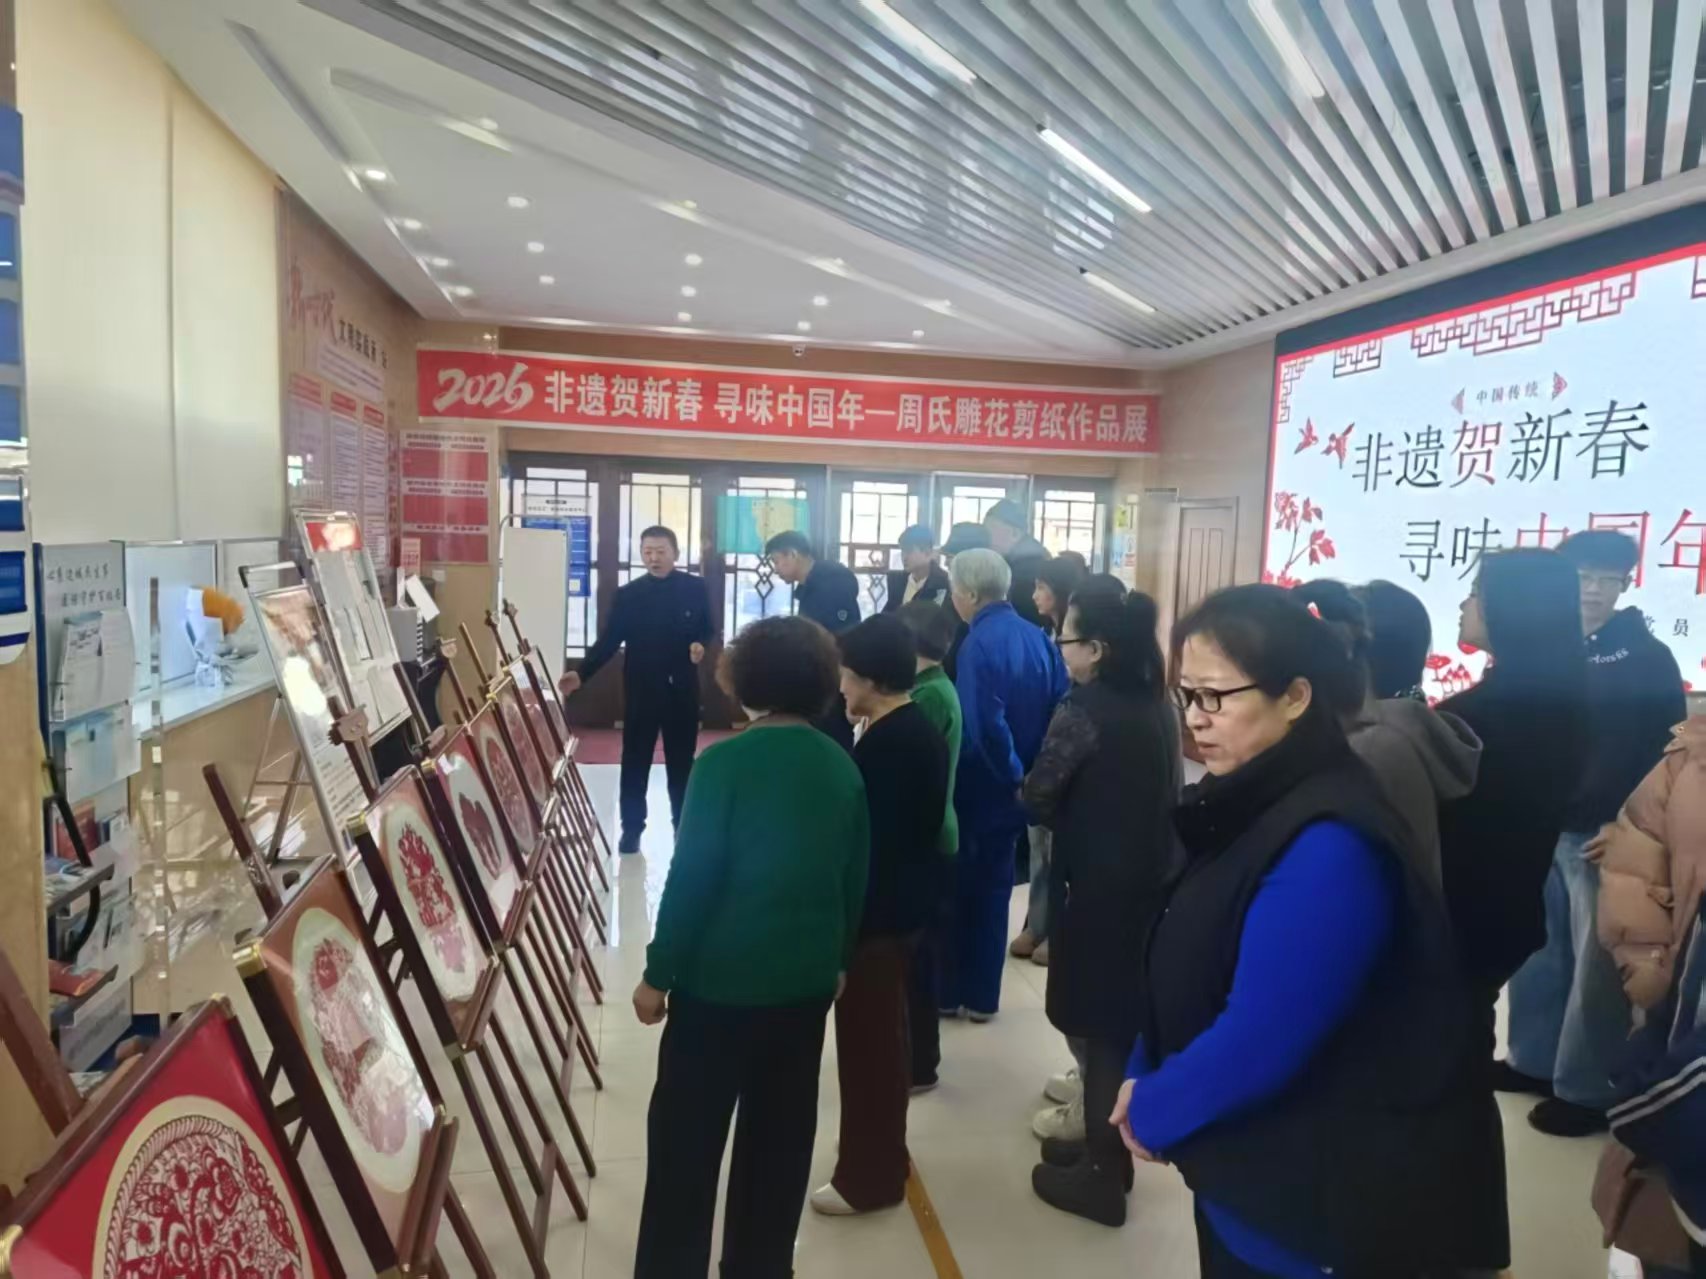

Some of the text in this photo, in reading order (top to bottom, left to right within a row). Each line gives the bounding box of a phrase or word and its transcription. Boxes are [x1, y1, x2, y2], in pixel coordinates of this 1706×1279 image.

[433, 362, 534, 413] 2026
[544, 370, 703, 421] 非遗贺新春
[1476, 381, 1539, 404] 中国传统
[1351, 399, 1650, 492] 非遗贺新春
